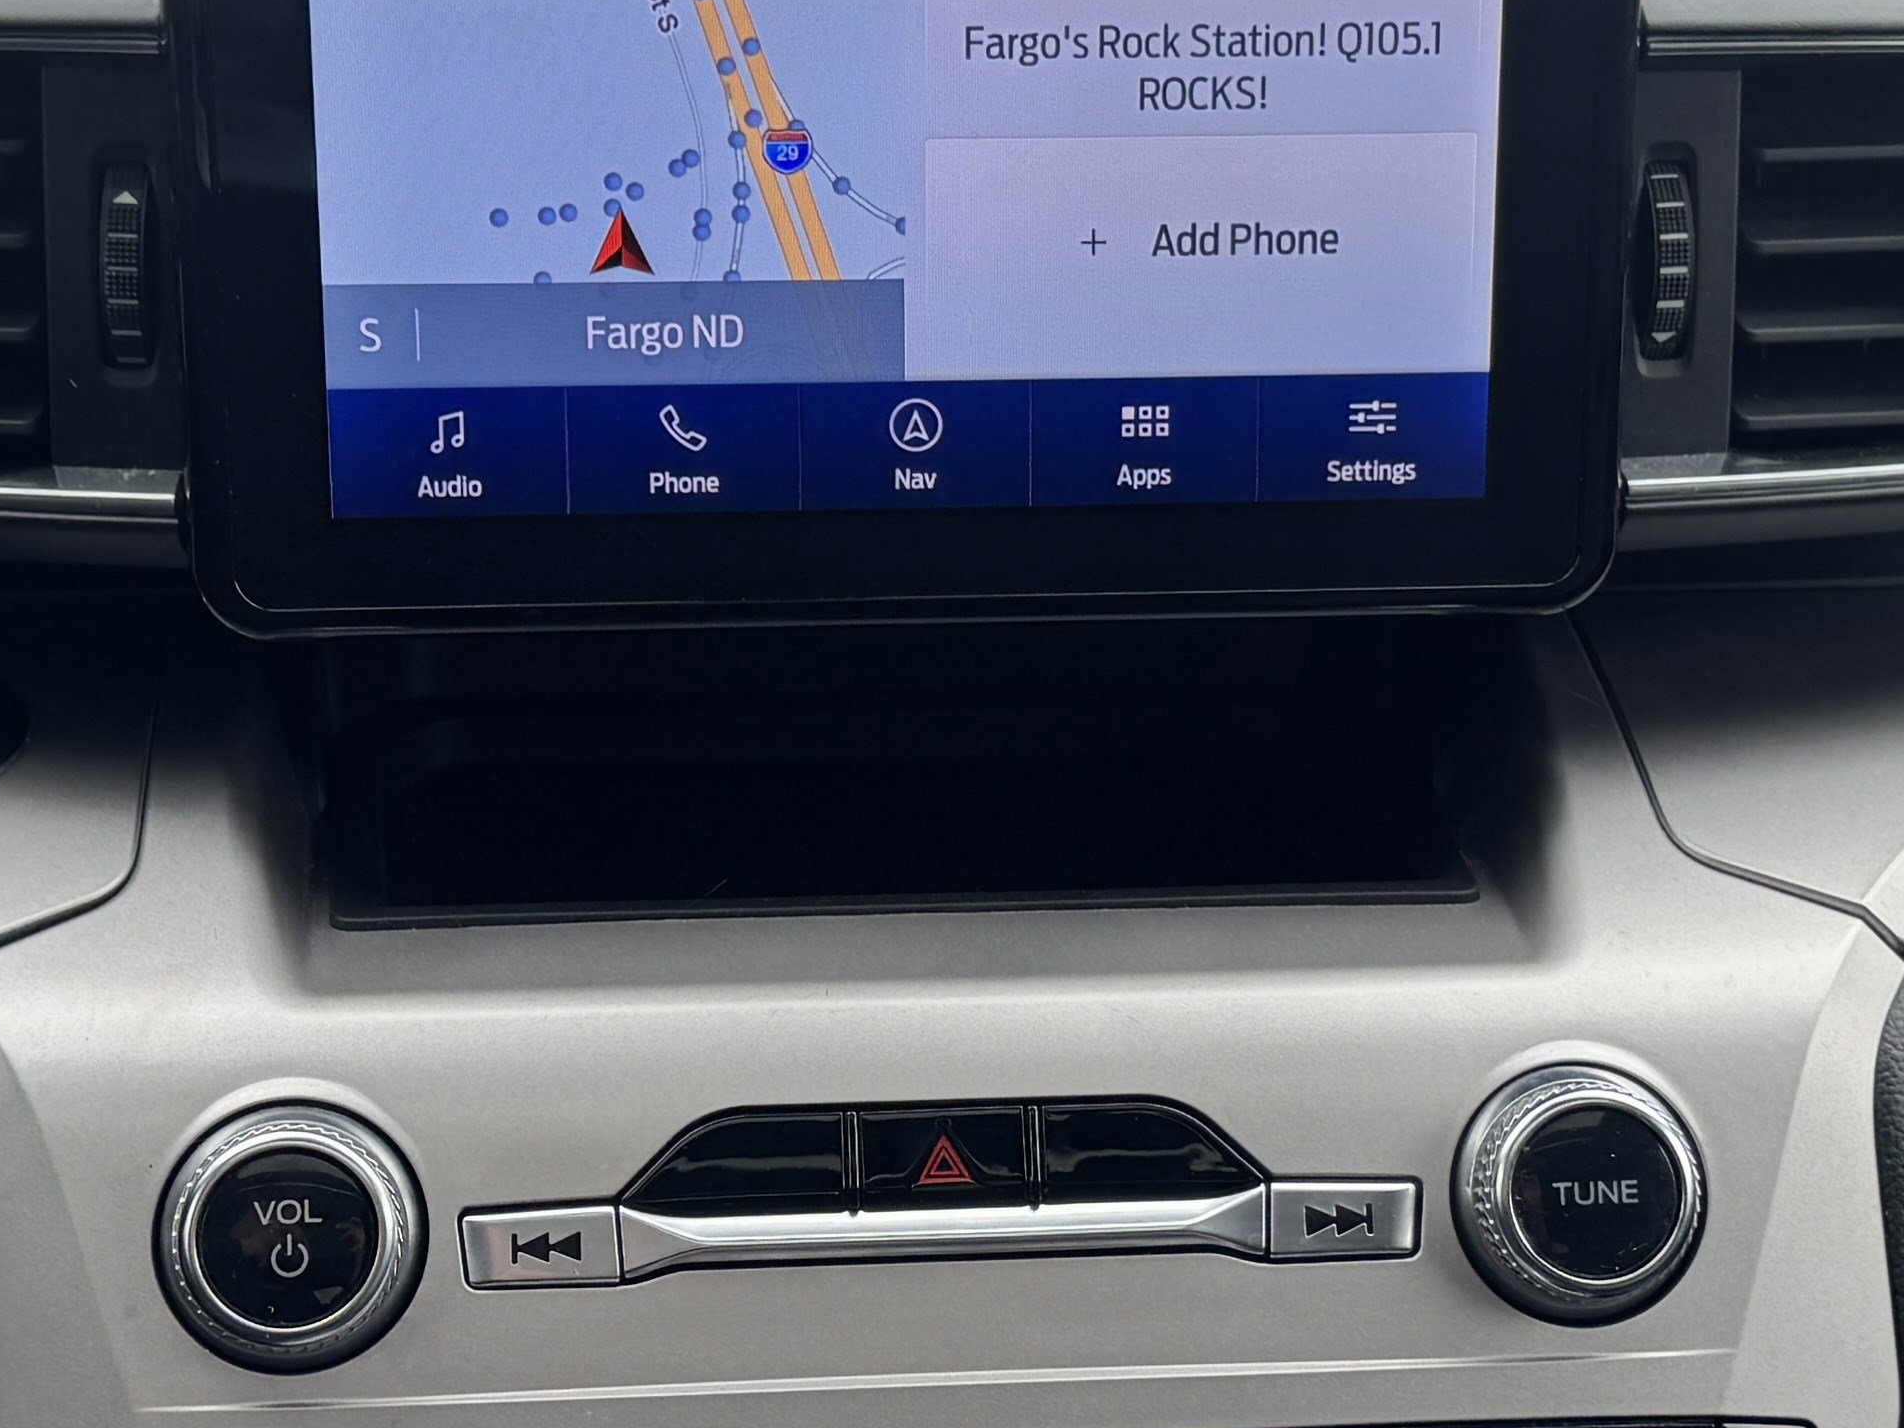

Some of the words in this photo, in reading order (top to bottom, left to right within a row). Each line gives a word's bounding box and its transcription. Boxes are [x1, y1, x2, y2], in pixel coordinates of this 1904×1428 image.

[657, 13, 679, 34] S
[965, 24, 1089, 67] Fargo's
[1098, 22, 1181, 59] Rock
[1190, 22, 1326, 58] Station!
[1337, 21, 1441, 64] Q105.1
[1139, 75, 1267, 111] ROCKS!
[776, 144, 799, 162] 29
[1151, 222, 1220, 257] Add
[1230, 221, 1339, 256] Phone
[359, 317, 382, 352] S
[586, 315, 684, 356] Fargo
[693, 314, 744, 349] ND
[649, 471, 720, 494] Phone
[894, 467, 938, 490] Nav
[1116, 463, 1172, 490] Apps
[1326, 459, 1417, 485] Settings
[417, 474, 483, 498] Audio
[1551, 1179, 1639, 1206] TUNE
[253, 1198, 323, 1226] VOL
